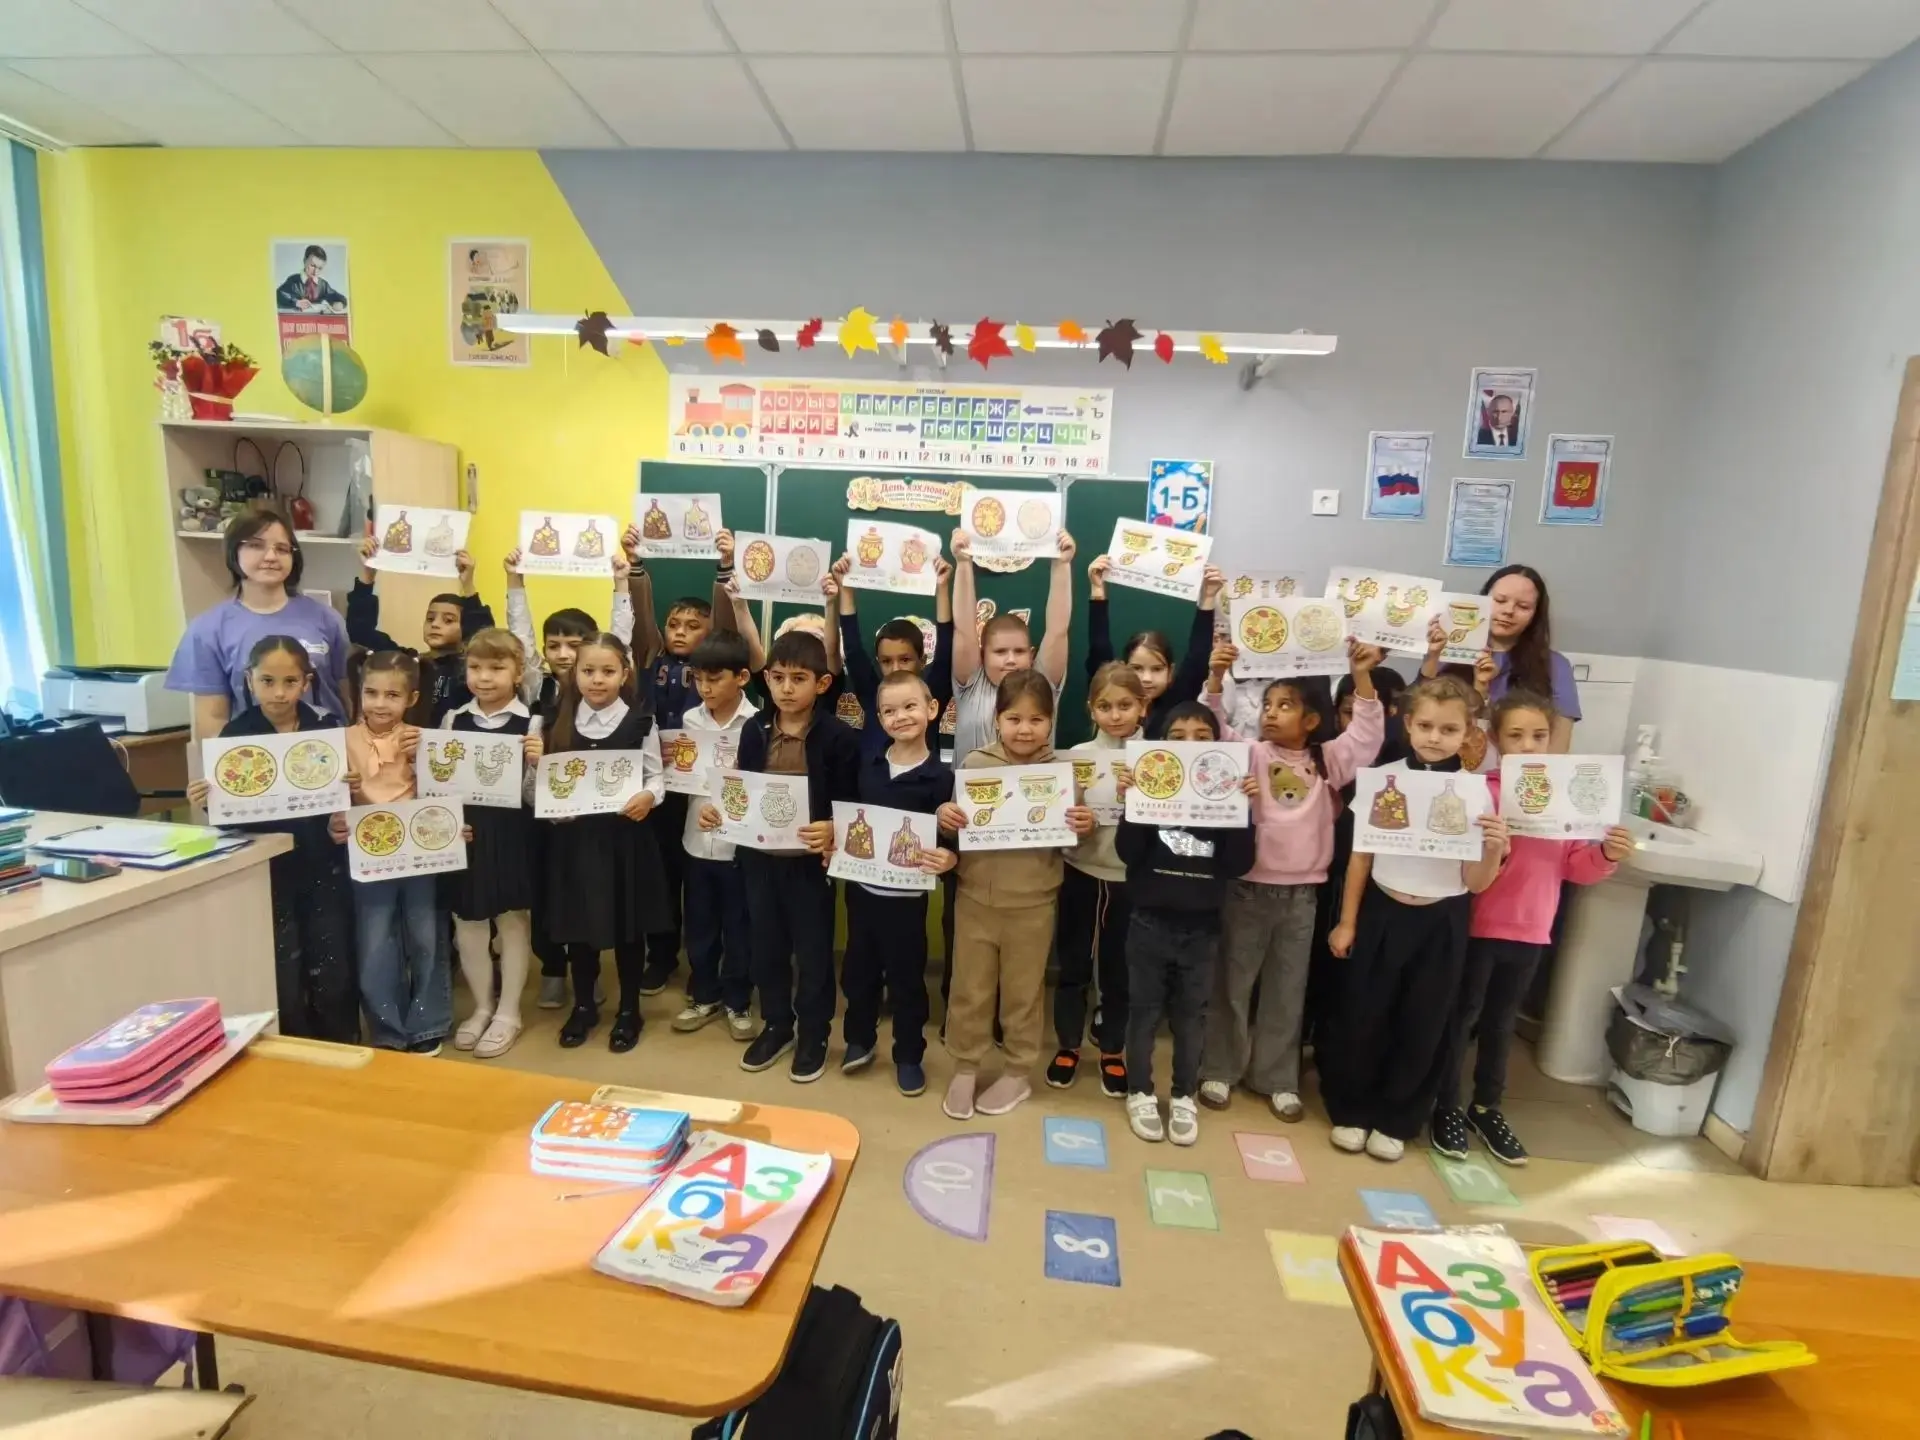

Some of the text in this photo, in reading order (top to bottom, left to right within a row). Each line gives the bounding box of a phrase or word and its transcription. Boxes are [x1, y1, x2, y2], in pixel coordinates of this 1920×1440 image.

[1159, 486, 1199, 510] 1-Б
[1051, 1131, 1101, 1150] 9
[919, 1160, 974, 1195] 10
[1154, 1186, 1205, 1208] 7
[1052, 1231, 1110, 1259] 8
